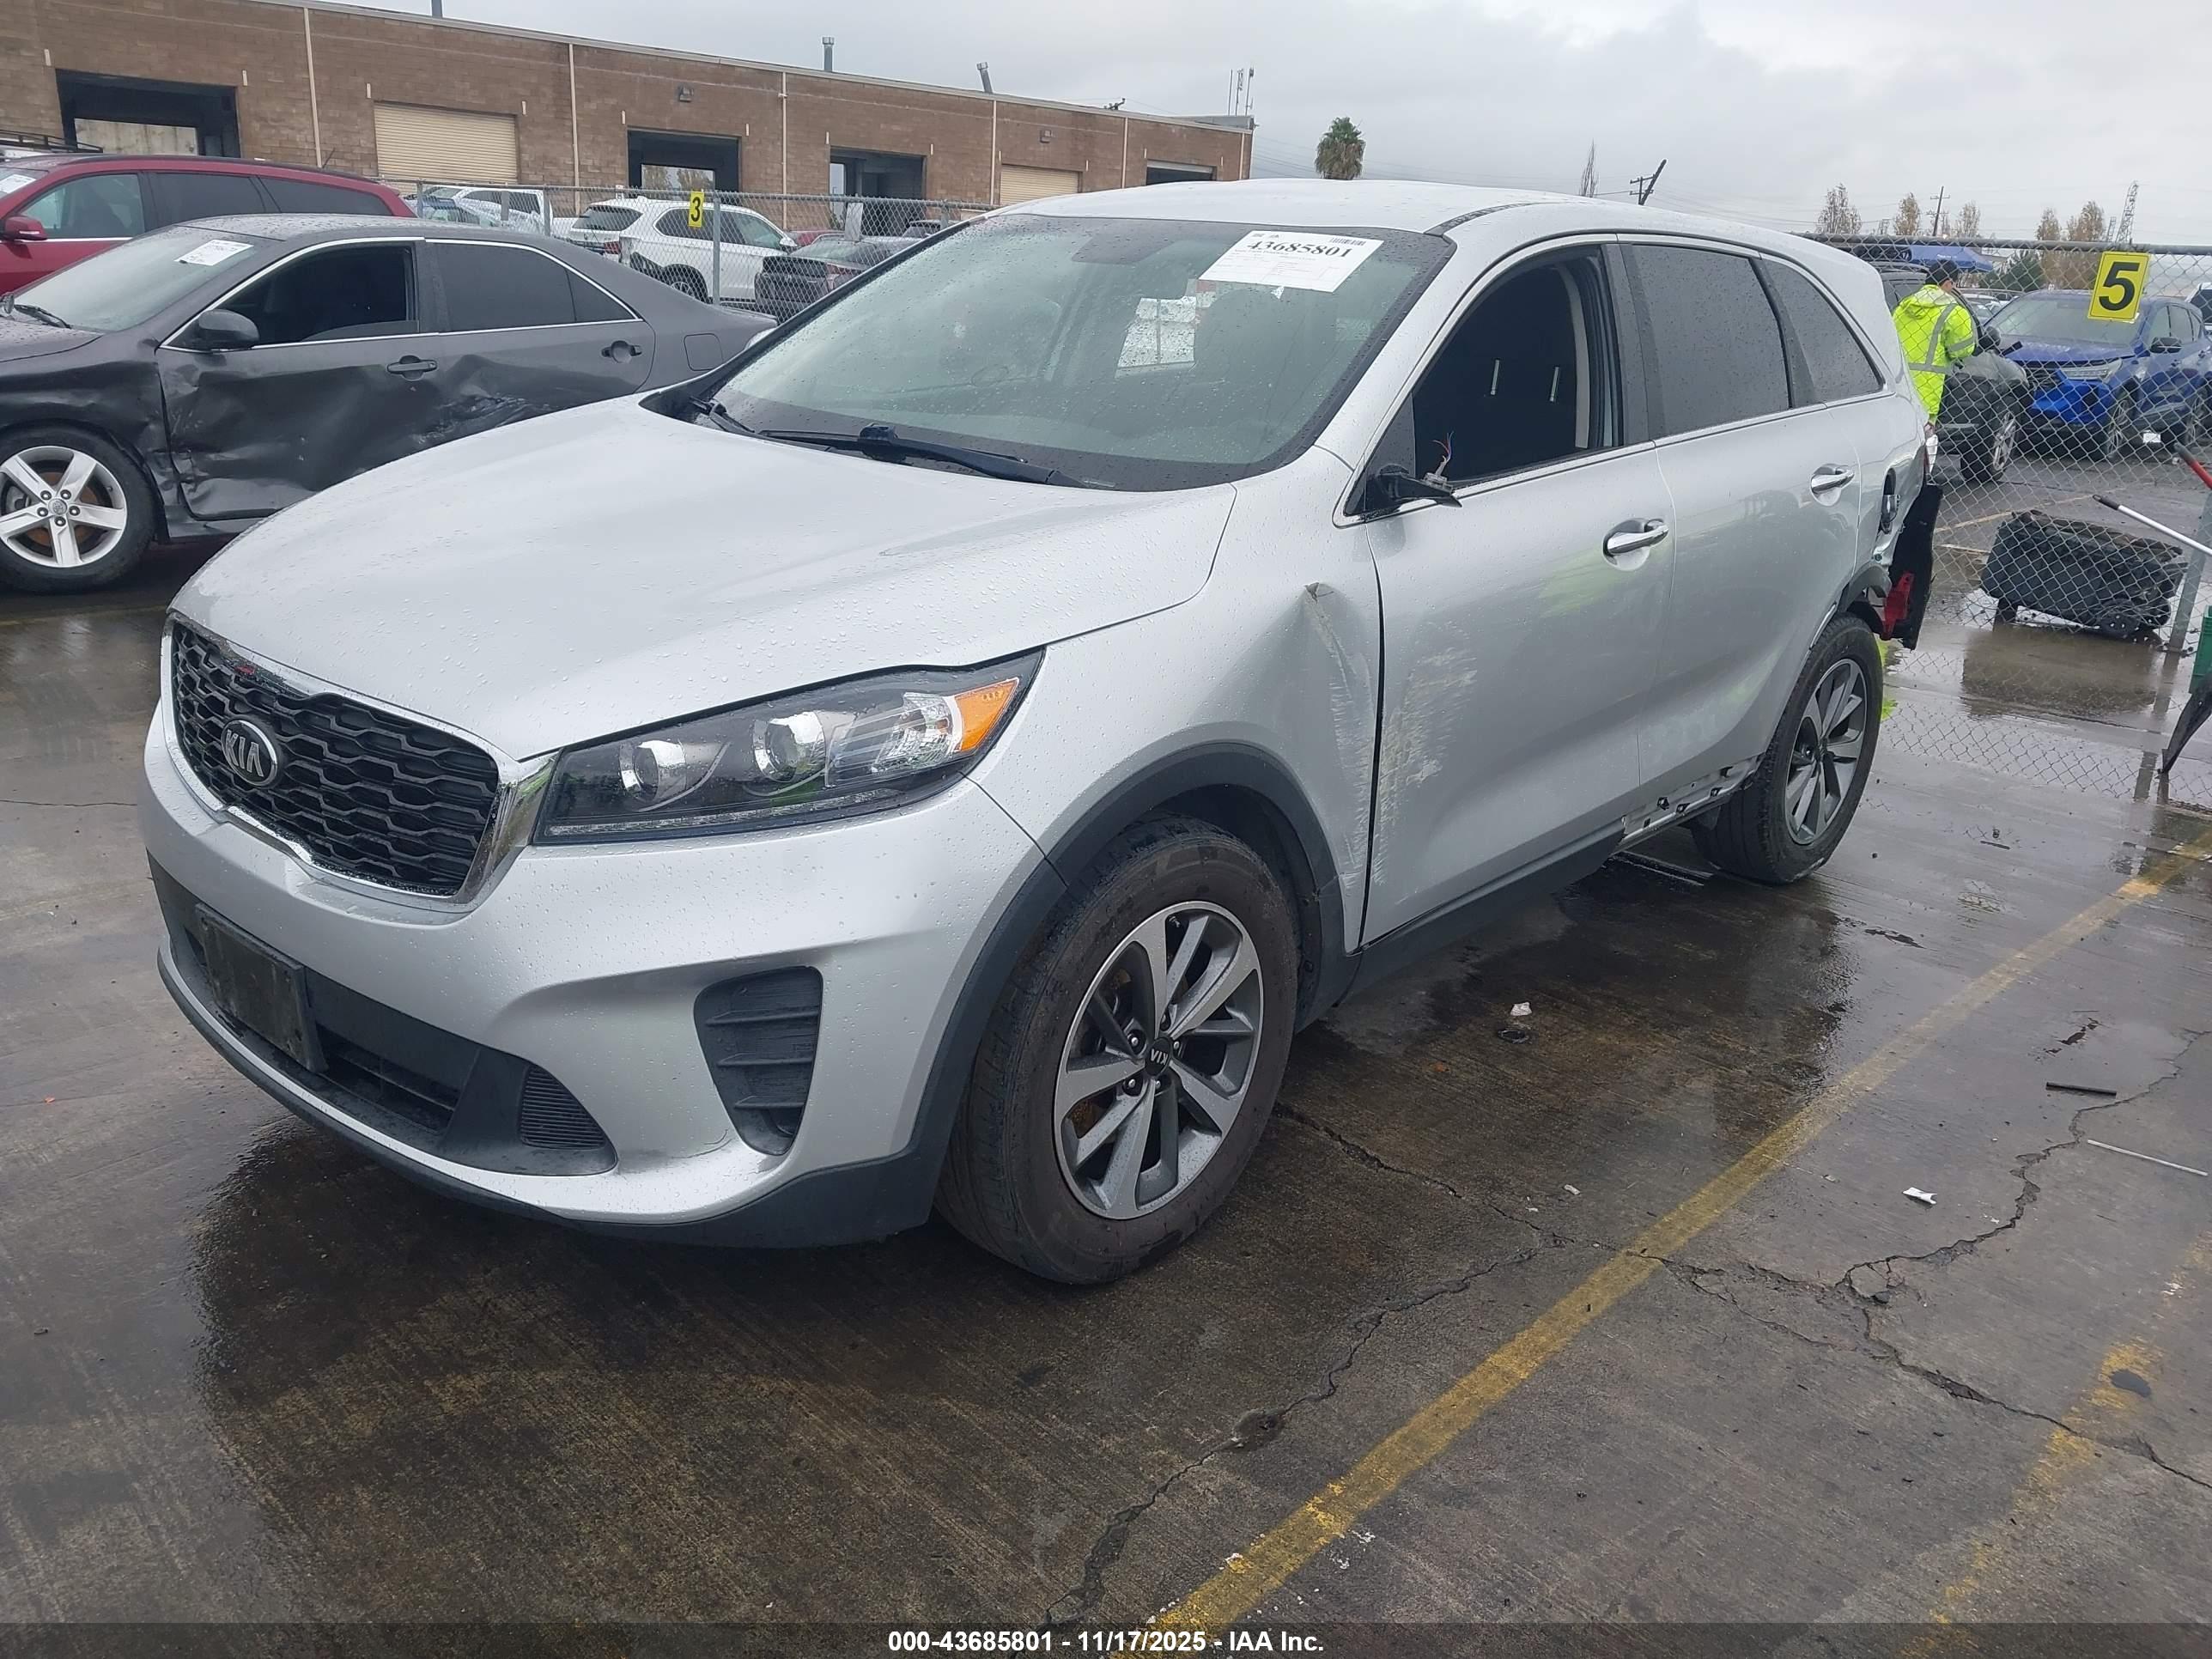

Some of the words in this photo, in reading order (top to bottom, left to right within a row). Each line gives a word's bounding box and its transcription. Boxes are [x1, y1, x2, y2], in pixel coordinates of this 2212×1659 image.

[691, 197, 701, 222] 3
[1247, 240, 1353, 258] 43685801
[2099, 261, 2140, 311] 5
[226, 729, 264, 777] KIA
[1151, 1048, 1169, 1065] KIA
